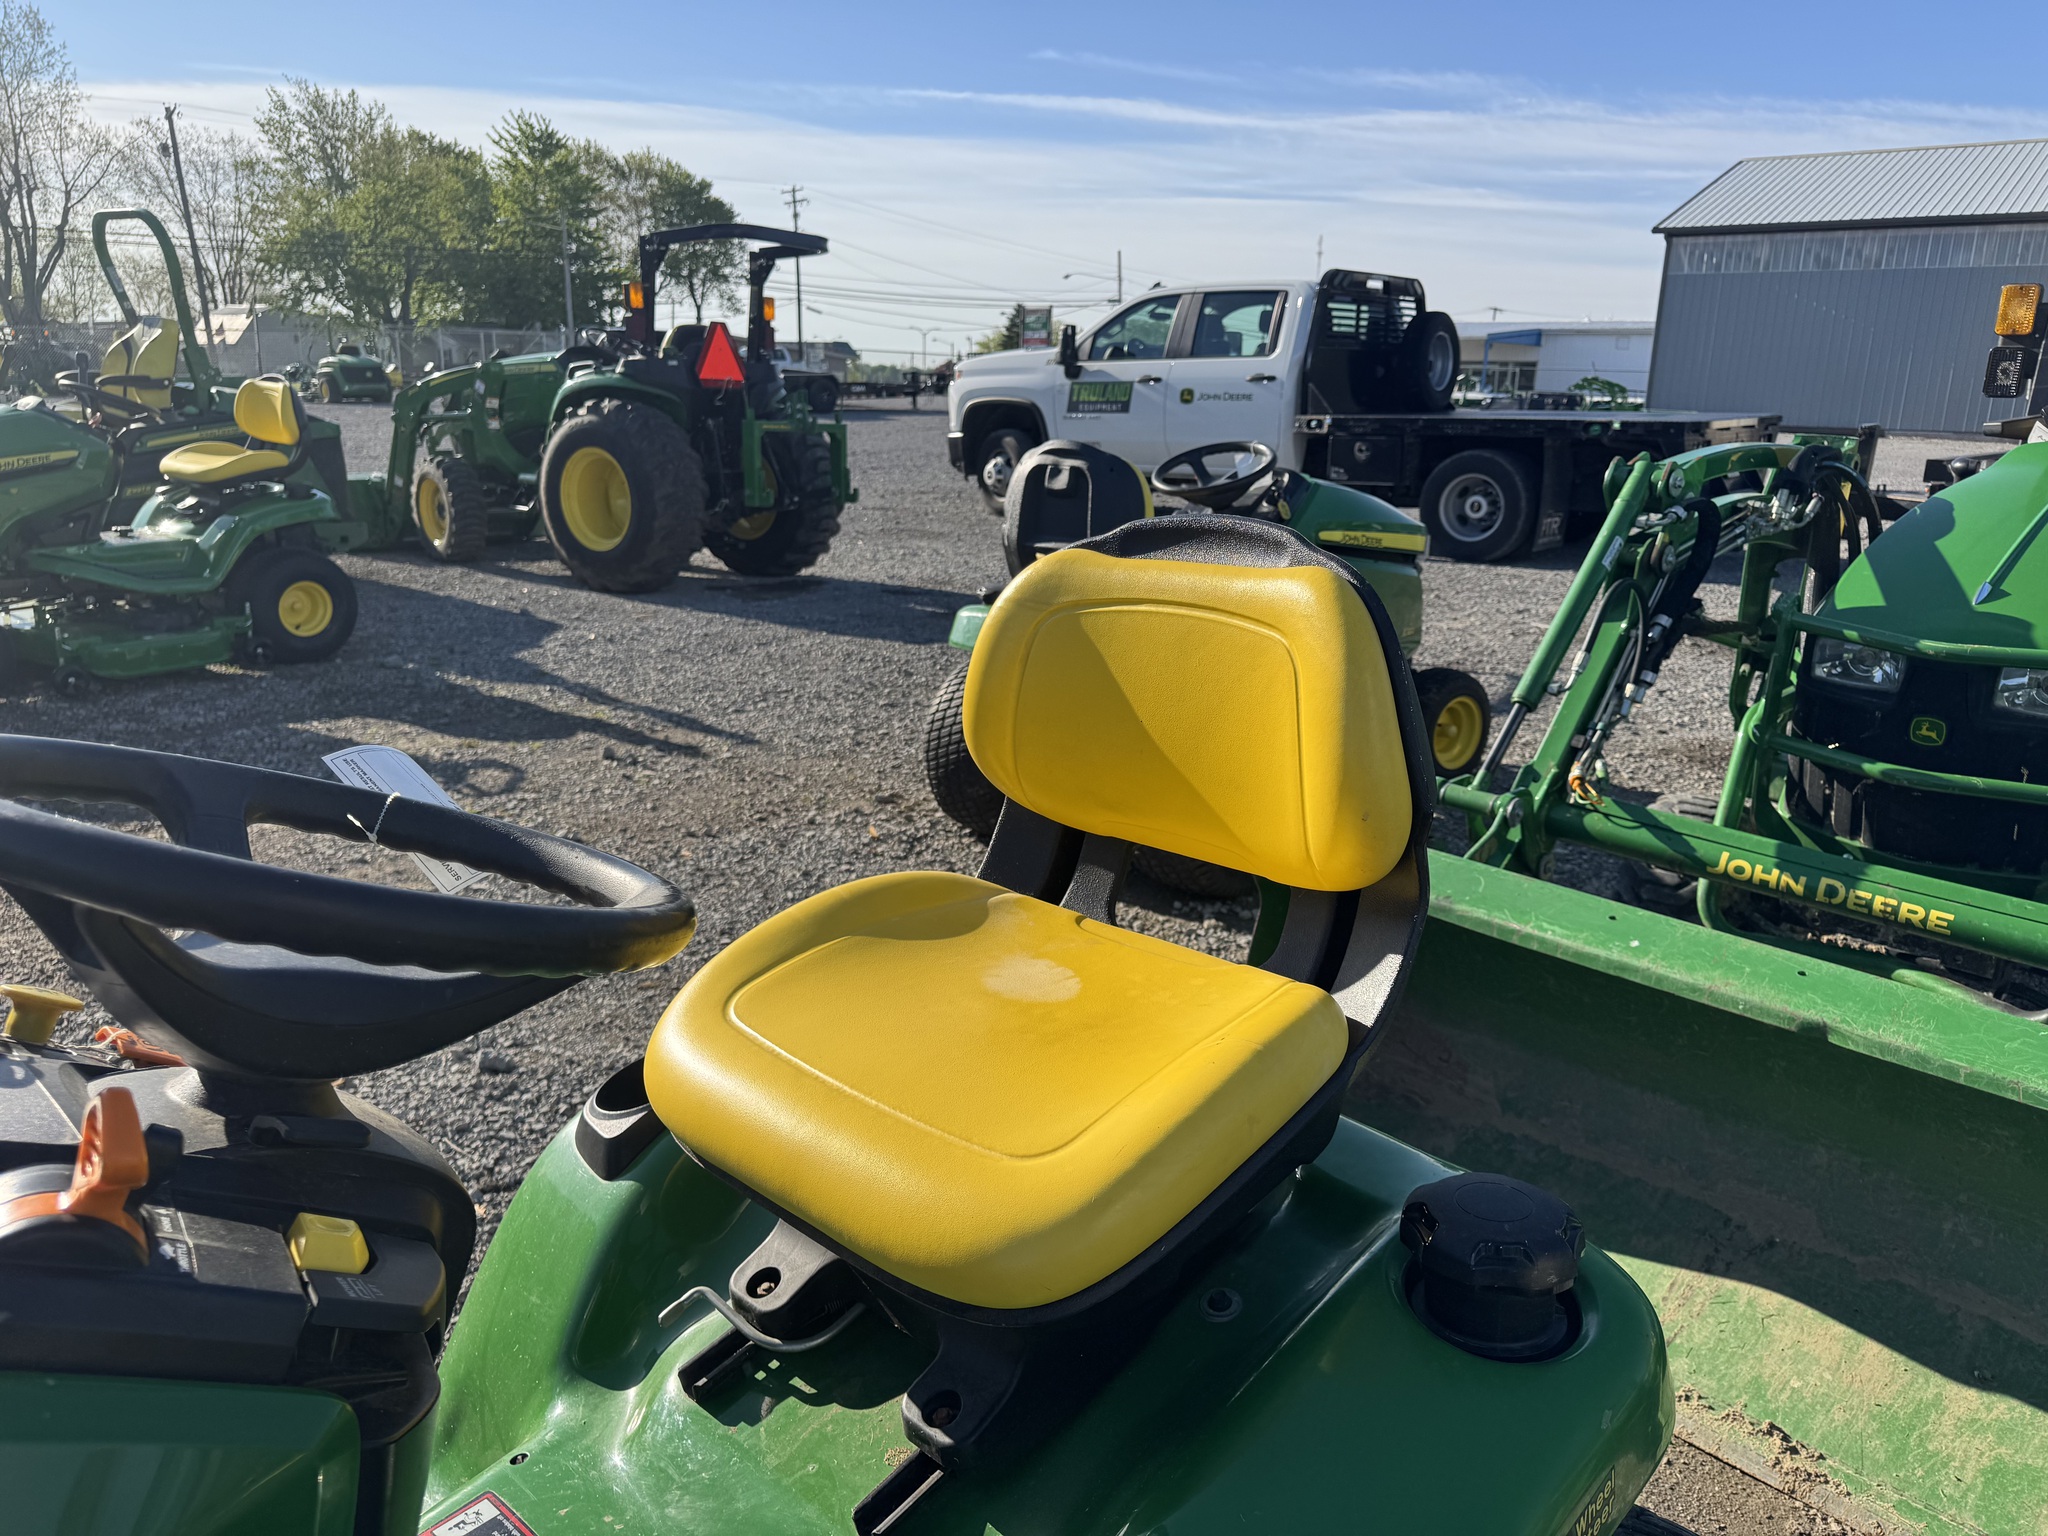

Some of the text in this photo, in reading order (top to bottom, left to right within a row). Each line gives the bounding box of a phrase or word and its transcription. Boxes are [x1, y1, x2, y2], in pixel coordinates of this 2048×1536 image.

[1071, 384, 1131, 402] TRULAND
[1197, 392, 1253, 401] JOHN DEERE
[1078, 403, 1121, 411] EQUIPMENT
[0, 455, 51, 471] HN DEERE
[1706, 851, 1955, 935] JOHN DEERE
[1575, 1469, 1615, 1536] Wheel
[1584, 1495, 1614, 1536] teer
